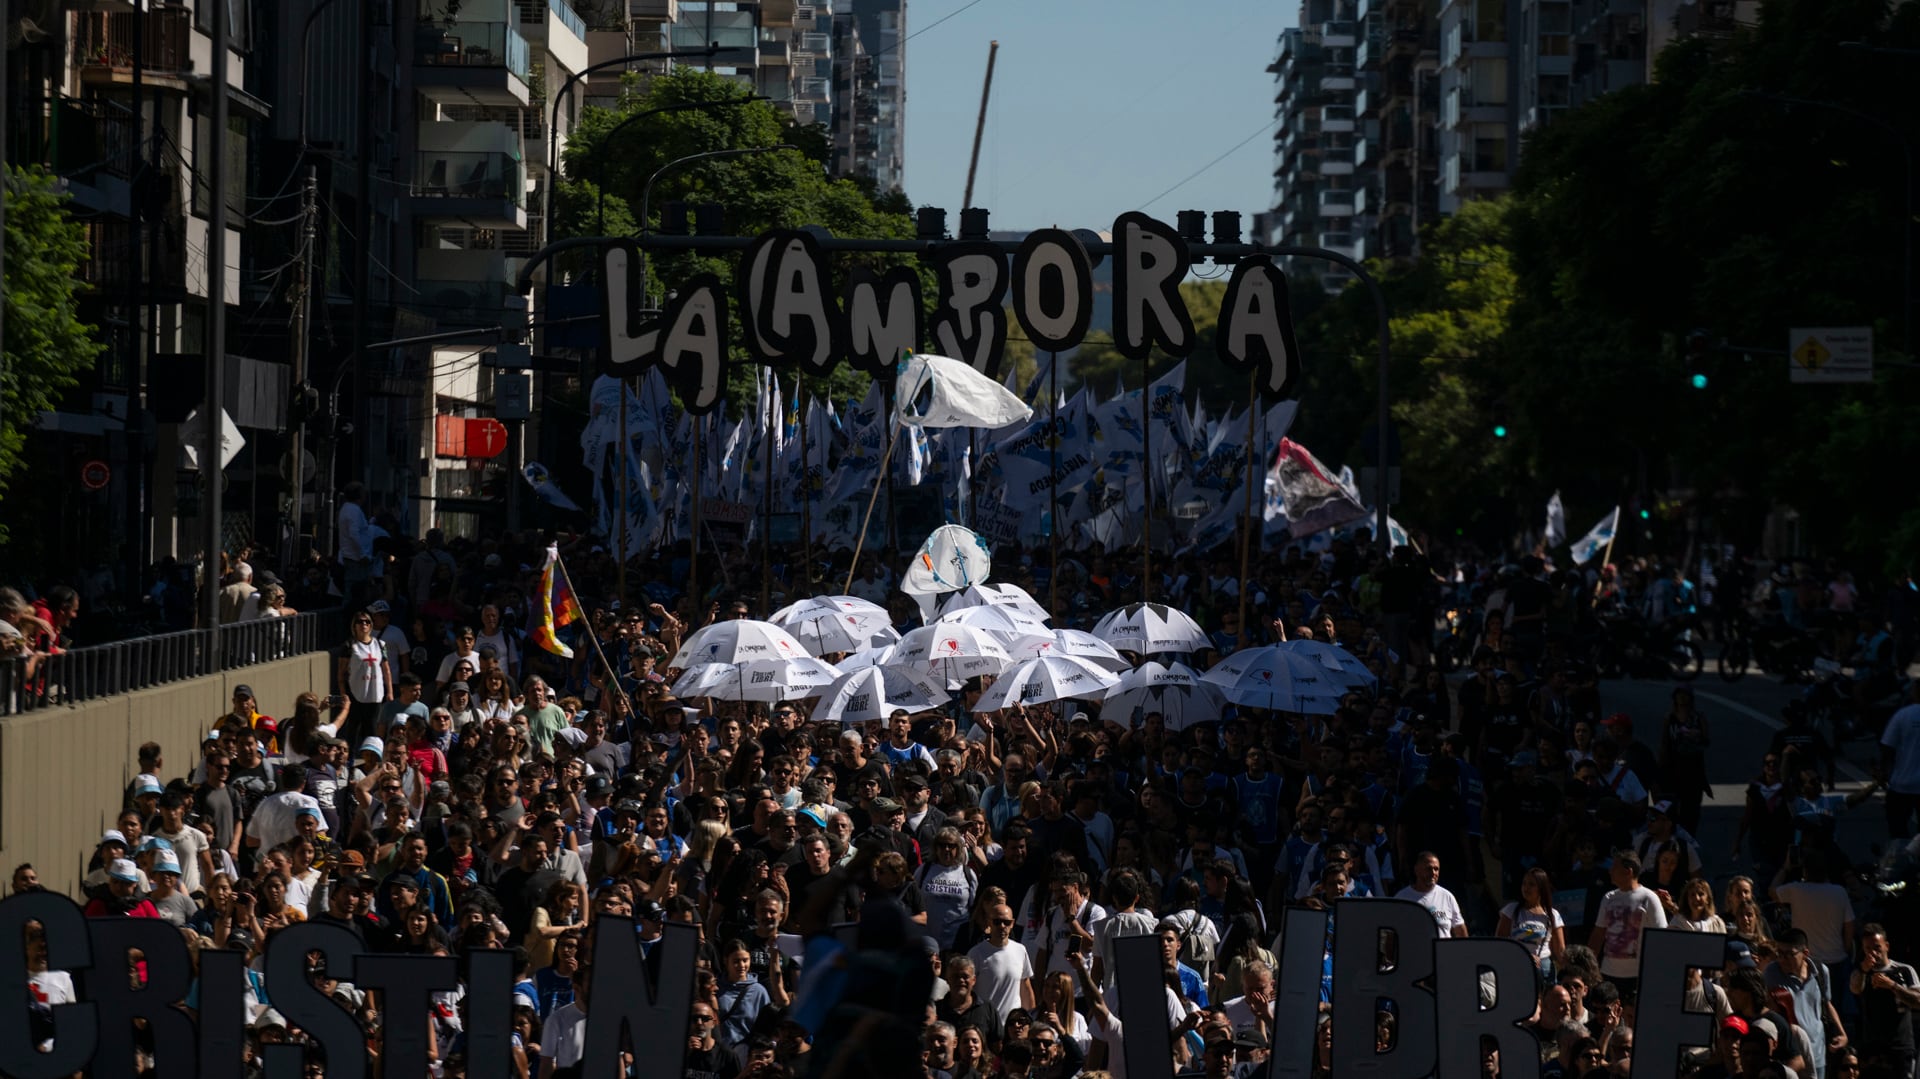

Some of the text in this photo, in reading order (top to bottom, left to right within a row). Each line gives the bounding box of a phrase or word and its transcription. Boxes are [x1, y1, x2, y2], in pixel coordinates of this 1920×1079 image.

[605, 247, 721, 408] LA
[846, 698, 869, 713] LIBRE
[925, 884, 963, 896] CRISTINA
